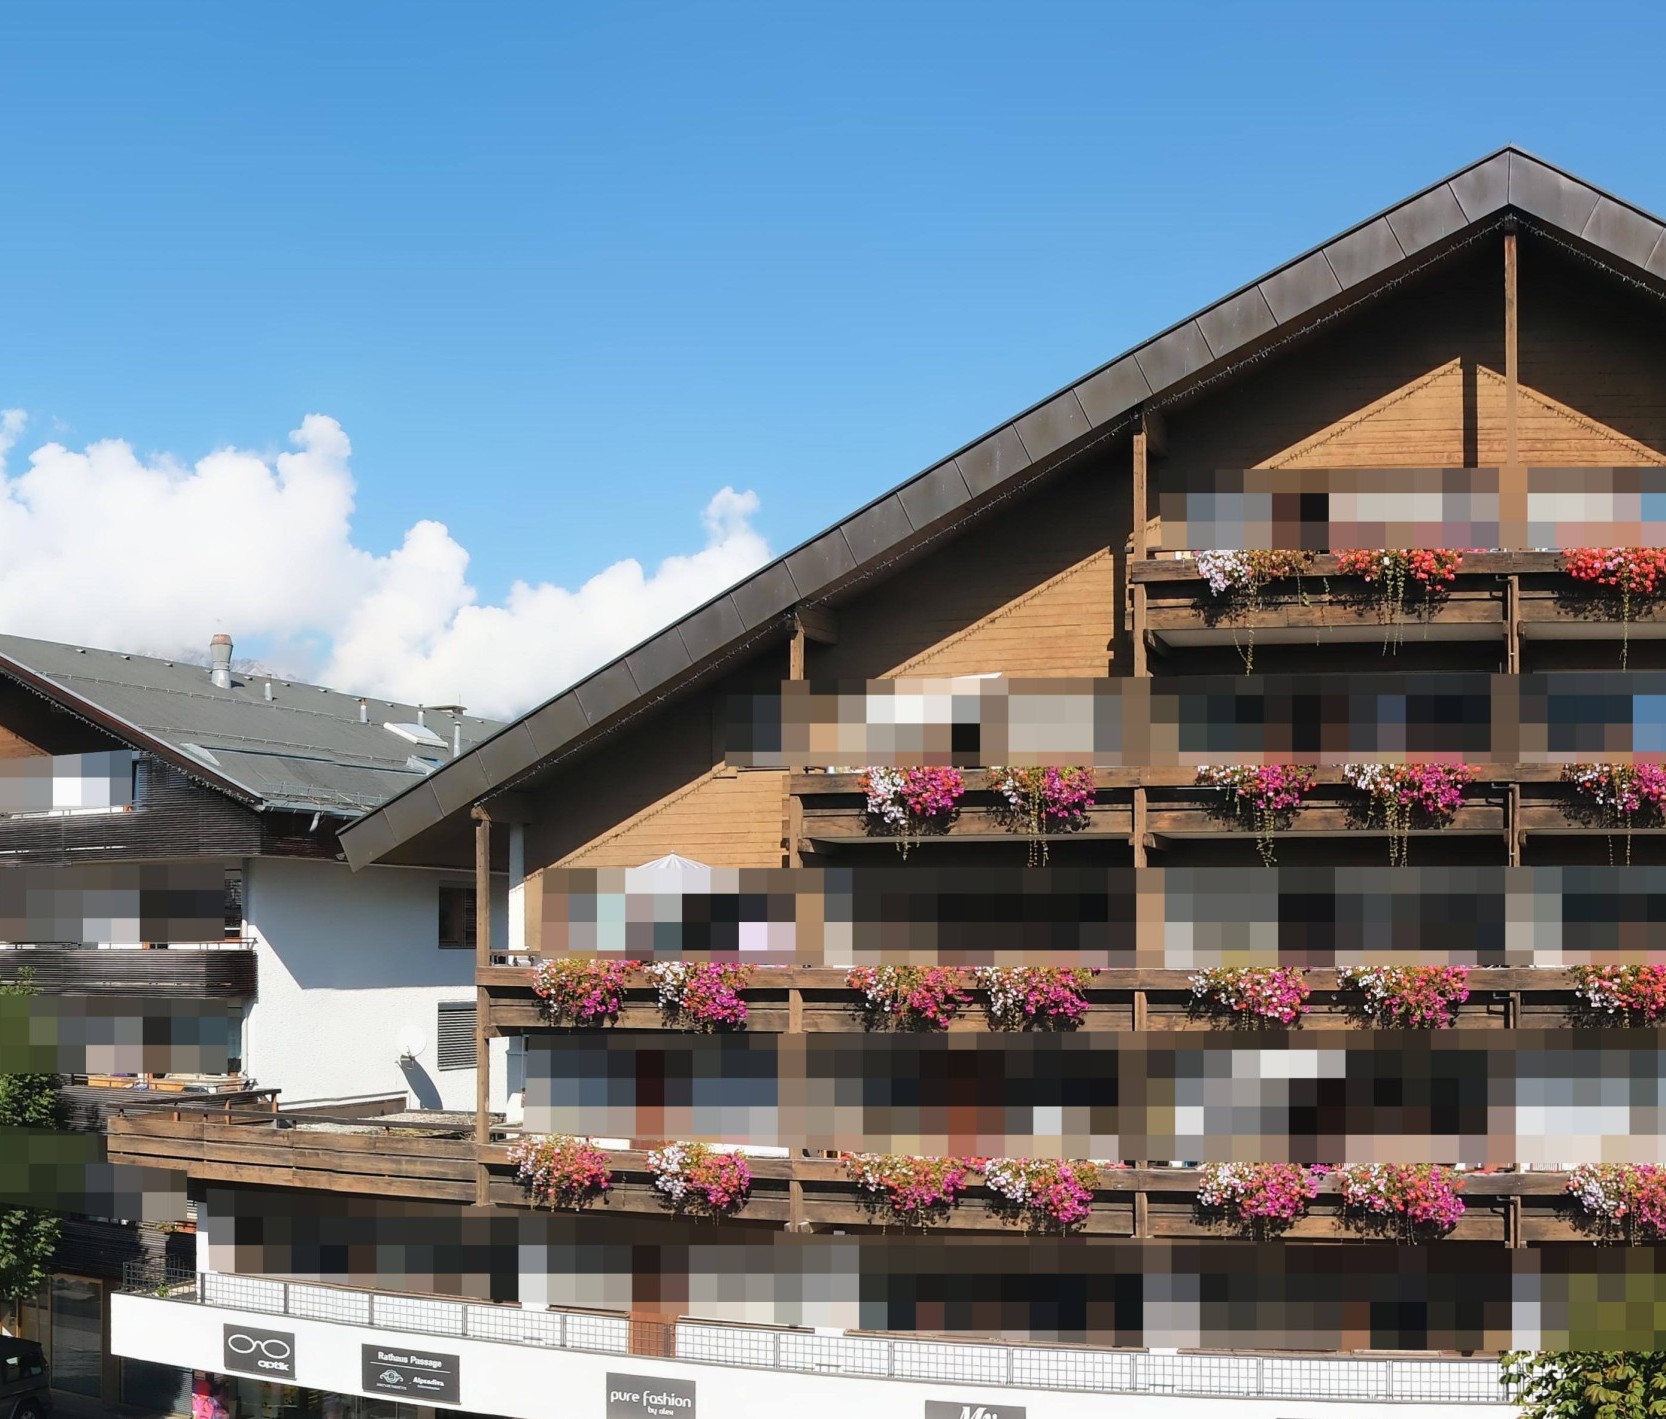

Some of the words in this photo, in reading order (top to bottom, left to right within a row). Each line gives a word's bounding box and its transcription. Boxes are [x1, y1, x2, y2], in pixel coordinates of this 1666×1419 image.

[258, 1359, 289, 1371] optik
[378, 1352, 408, 1364] Rathaus
[410, 1355, 442, 1369] Passage
[610, 1390, 641, 1403] pure
[643, 1390, 692, 1408] fashion
[647, 1406, 657, 1415] by
